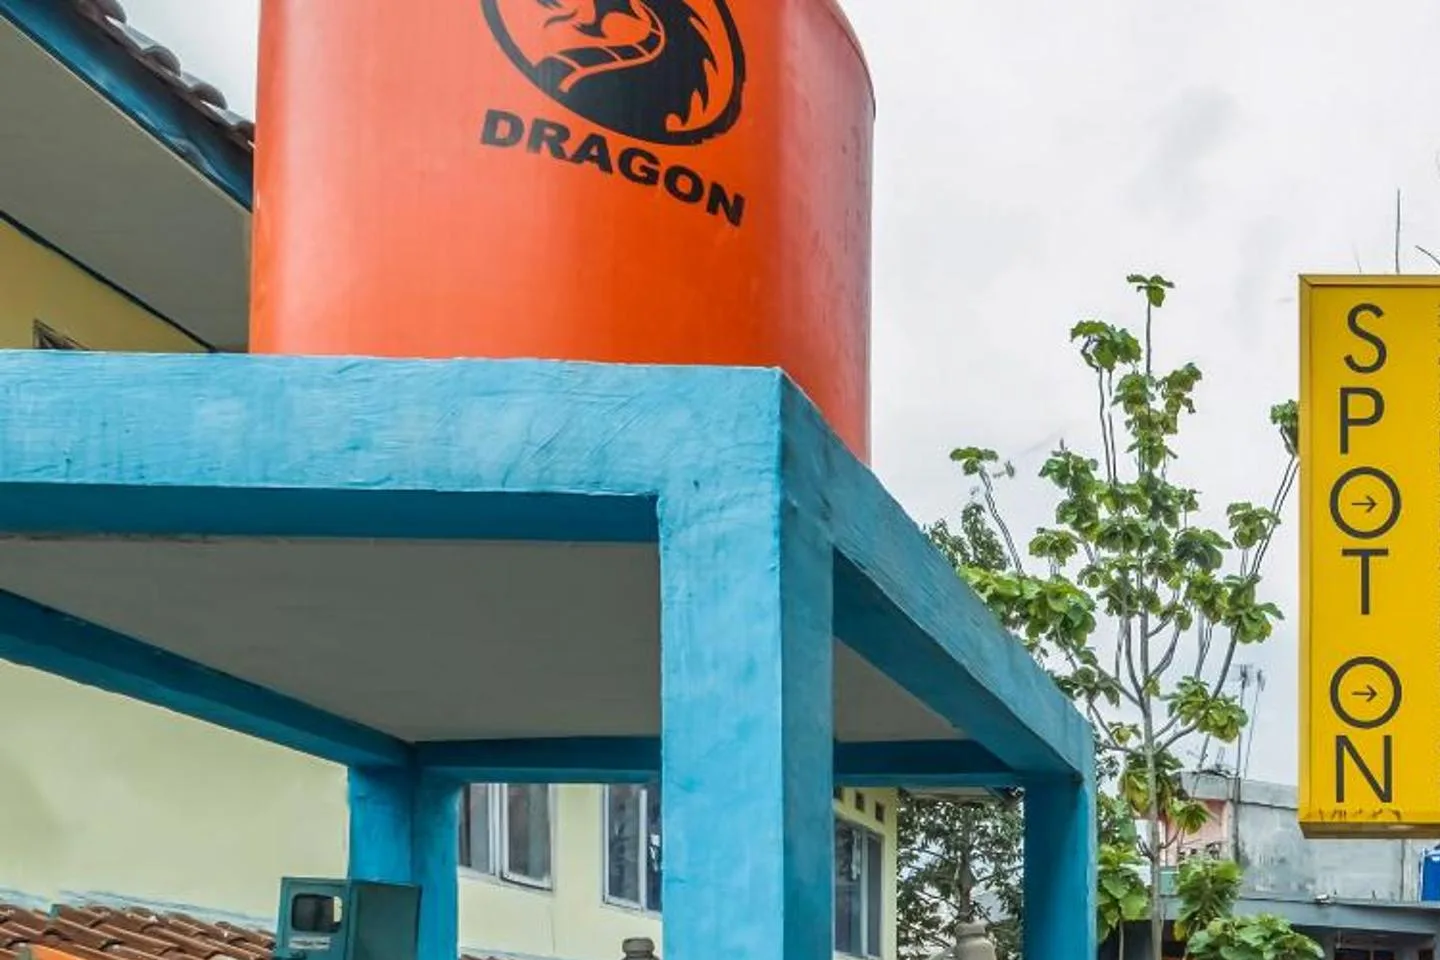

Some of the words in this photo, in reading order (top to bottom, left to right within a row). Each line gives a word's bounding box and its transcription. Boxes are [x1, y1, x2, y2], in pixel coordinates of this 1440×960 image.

[480, 108, 746, 227] DRAGON
[1329, 302, 1402, 615] SPOT
[1330, 655, 1402, 803] ON
